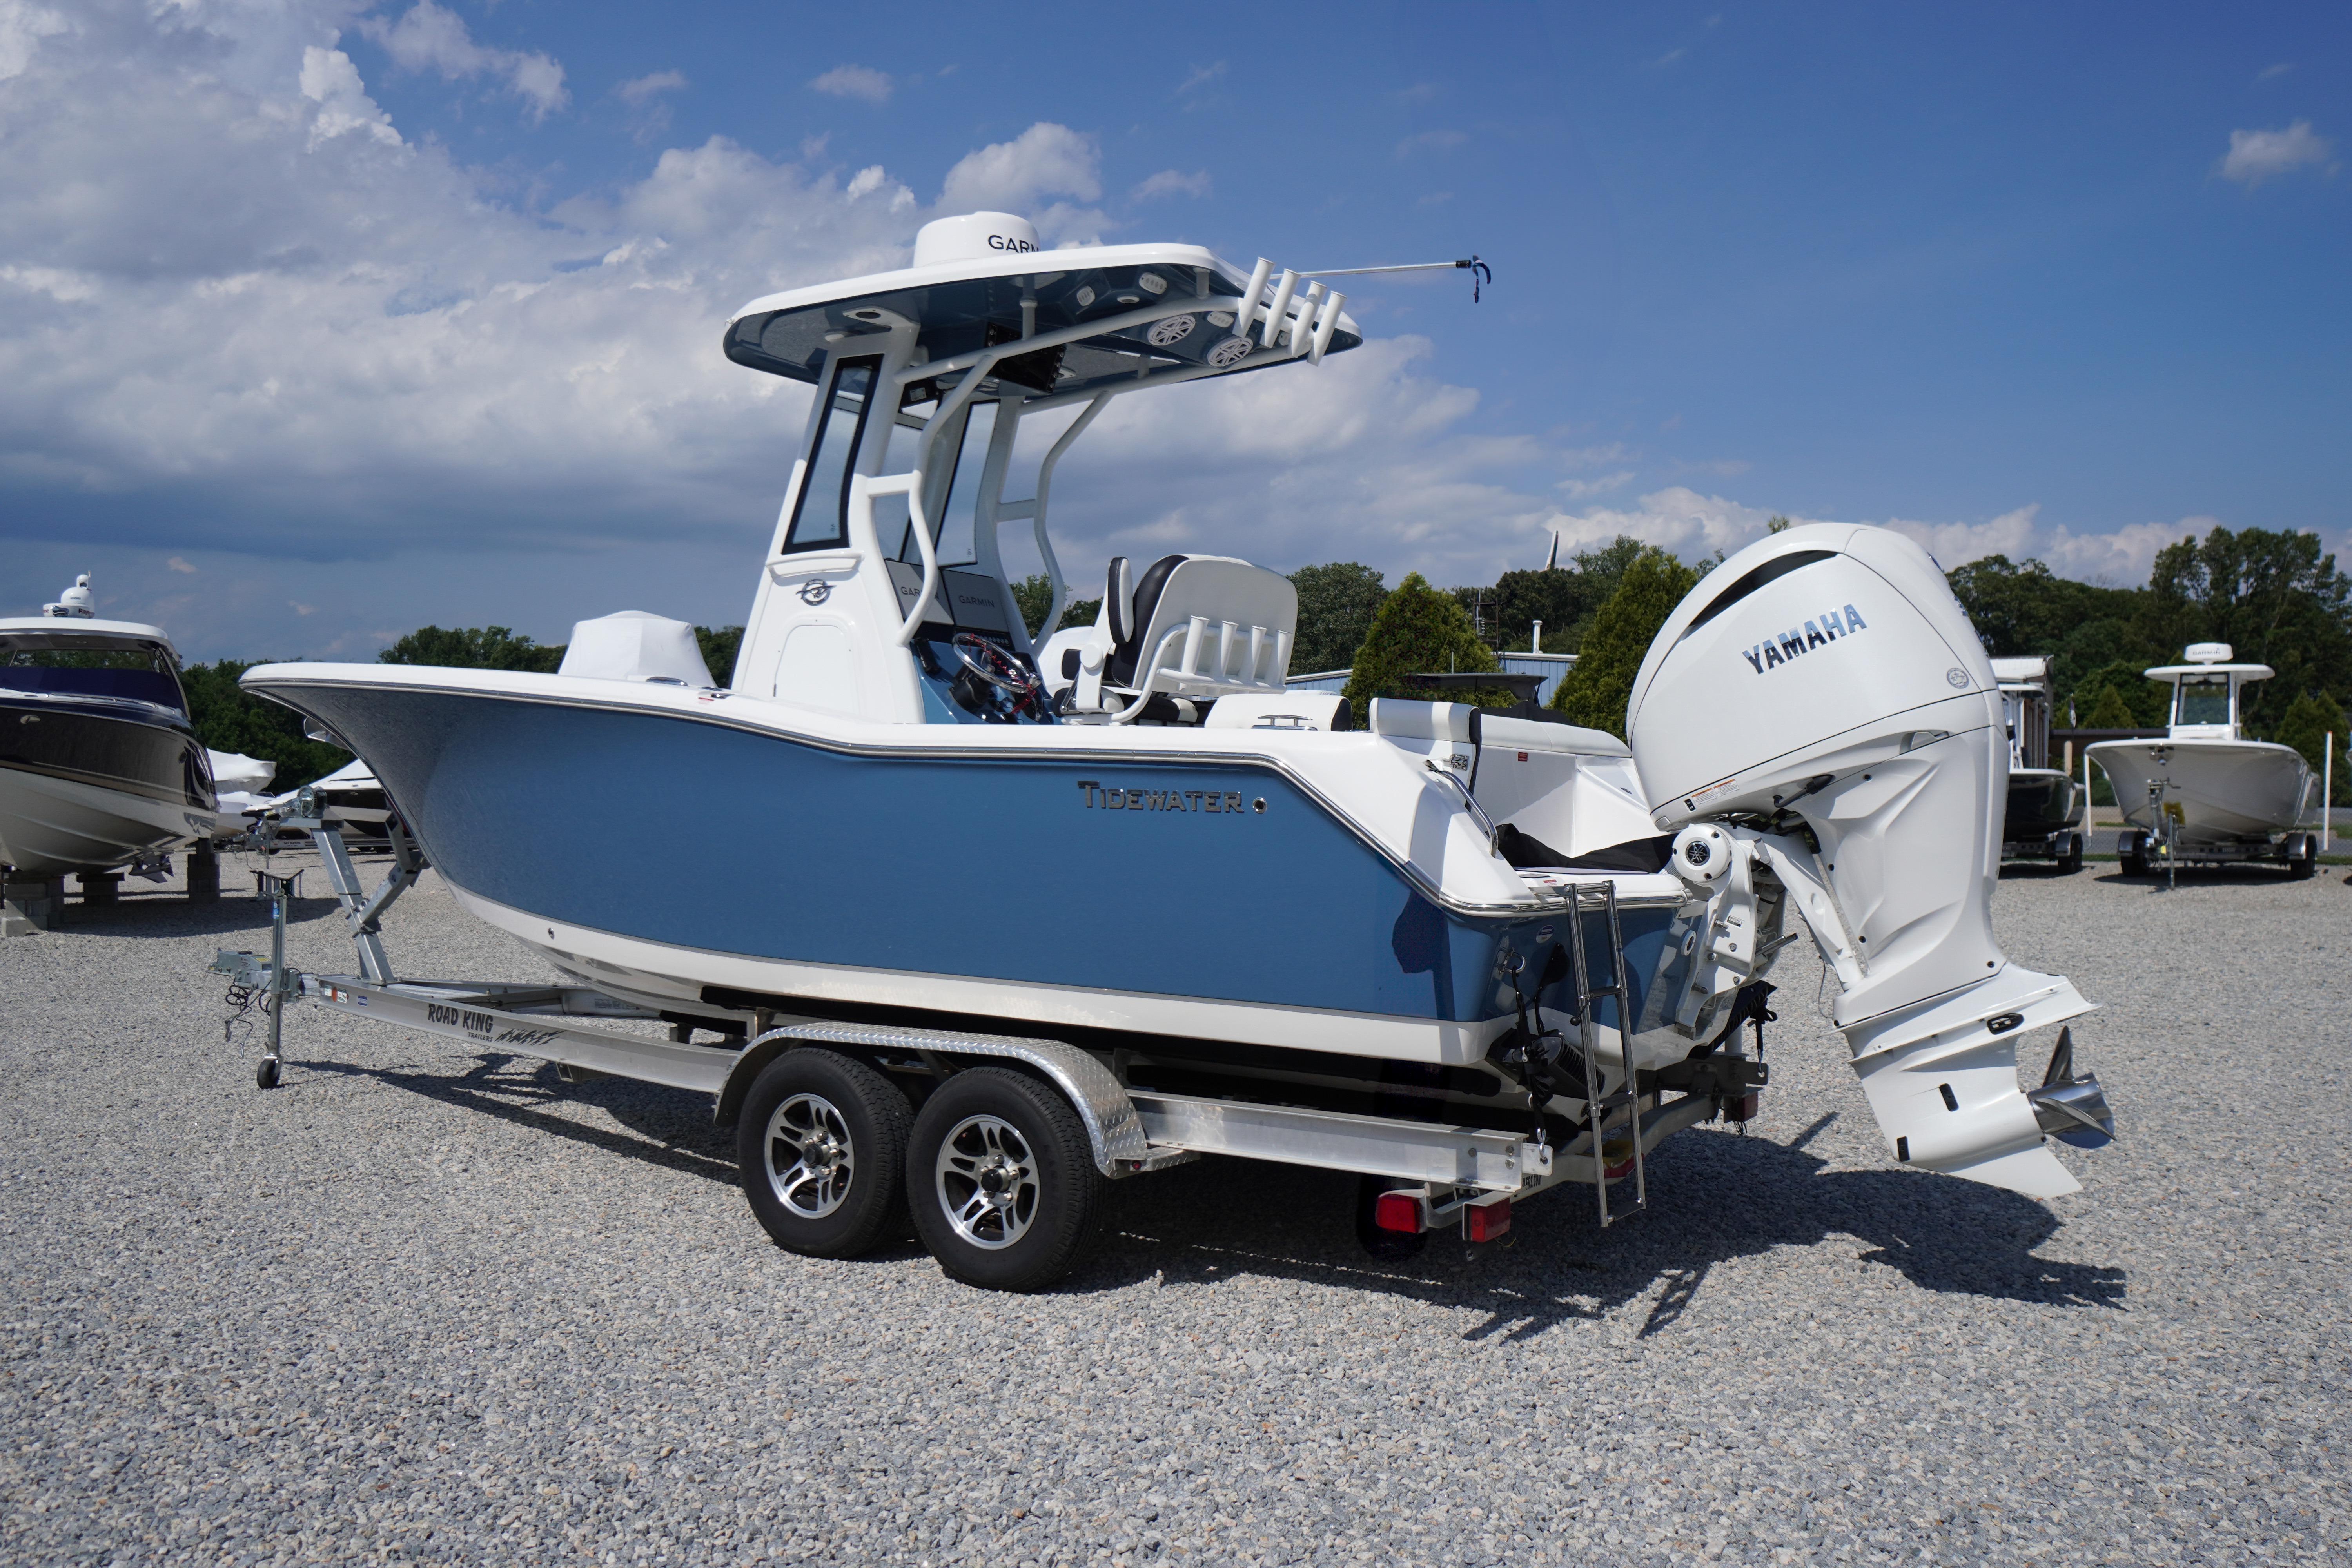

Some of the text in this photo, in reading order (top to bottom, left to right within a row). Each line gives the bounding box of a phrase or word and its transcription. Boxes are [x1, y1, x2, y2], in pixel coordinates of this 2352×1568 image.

[959, 595, 995, 607] GARMIN
[1742, 604, 1867, 675] YAMAHA
[1078, 780, 1245, 813] TIDEWATER
[428, 1004, 494, 1033] ROAD KING
[468, 1032, 493, 1042] TRAILERS
